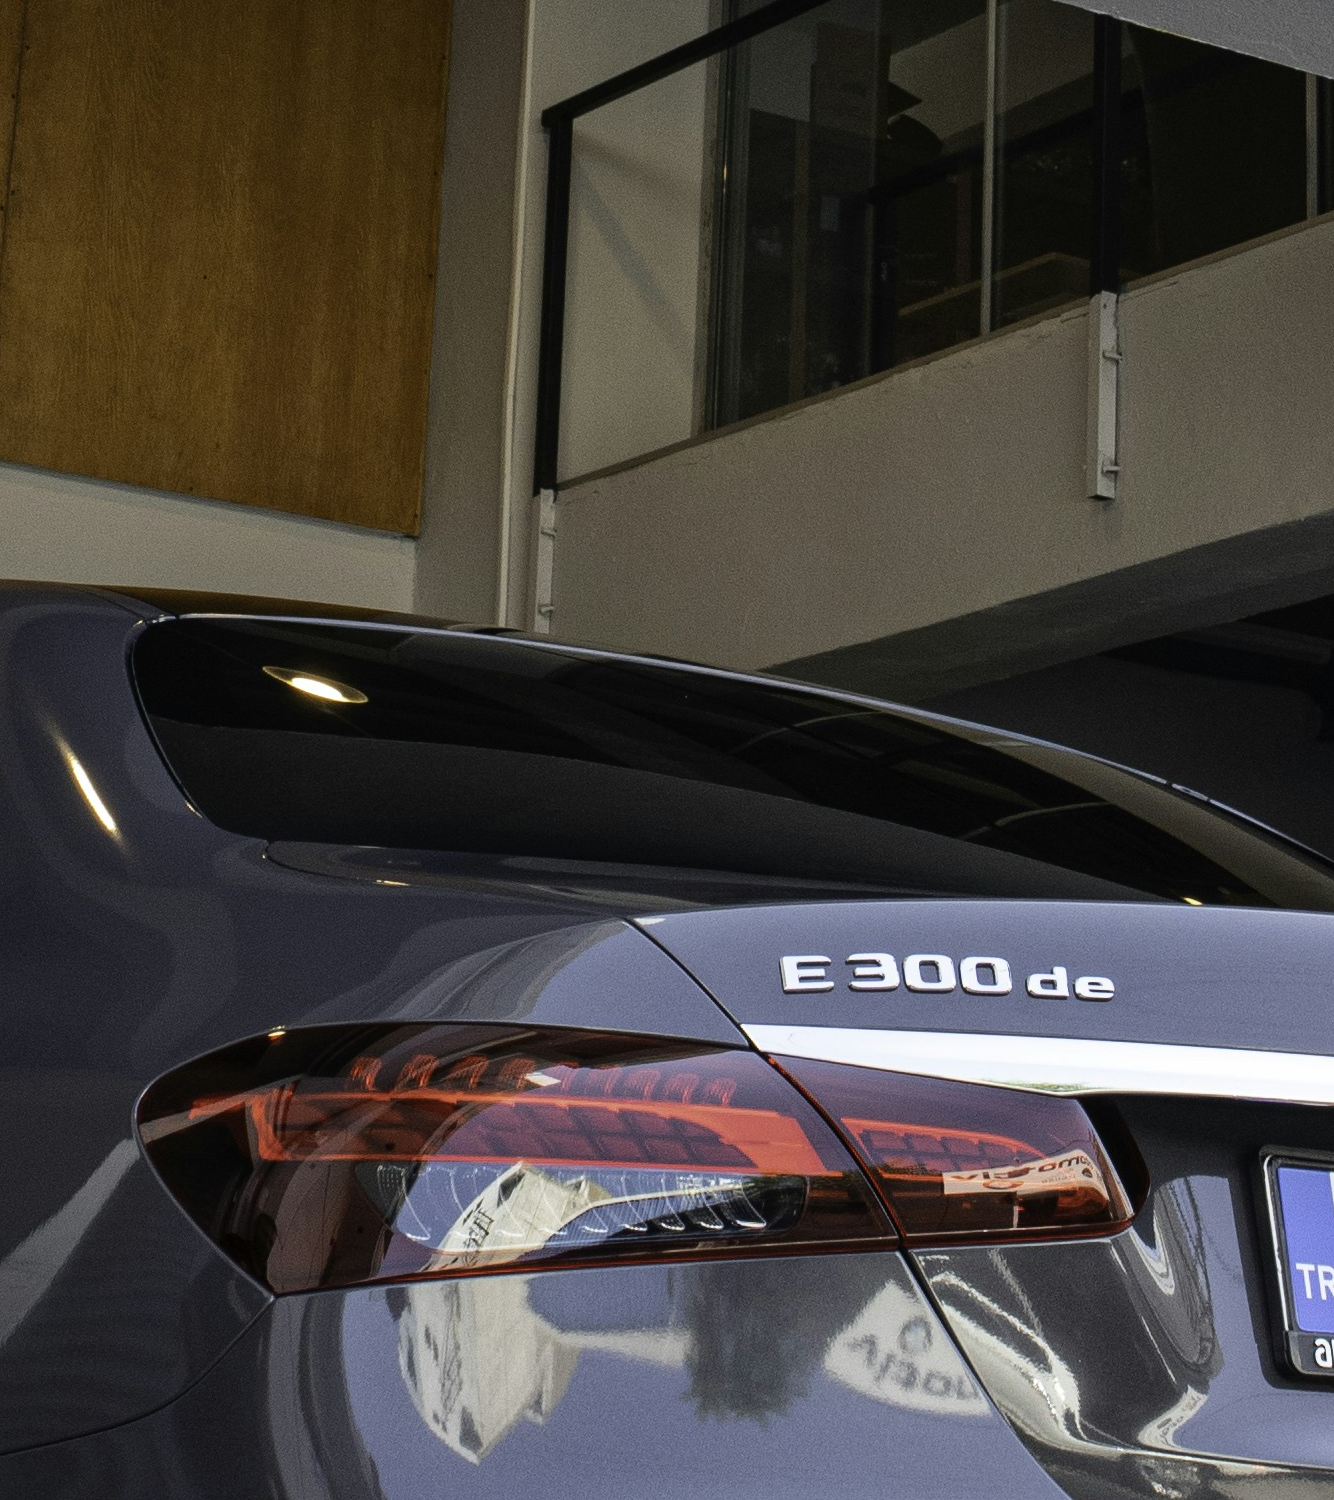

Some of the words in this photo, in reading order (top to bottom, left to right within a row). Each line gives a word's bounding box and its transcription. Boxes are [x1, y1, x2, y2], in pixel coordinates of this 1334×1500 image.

[780, 955, 834, 992] E
[847, 952, 1012, 995] 300
[1027, 966, 1116, 1000] de
